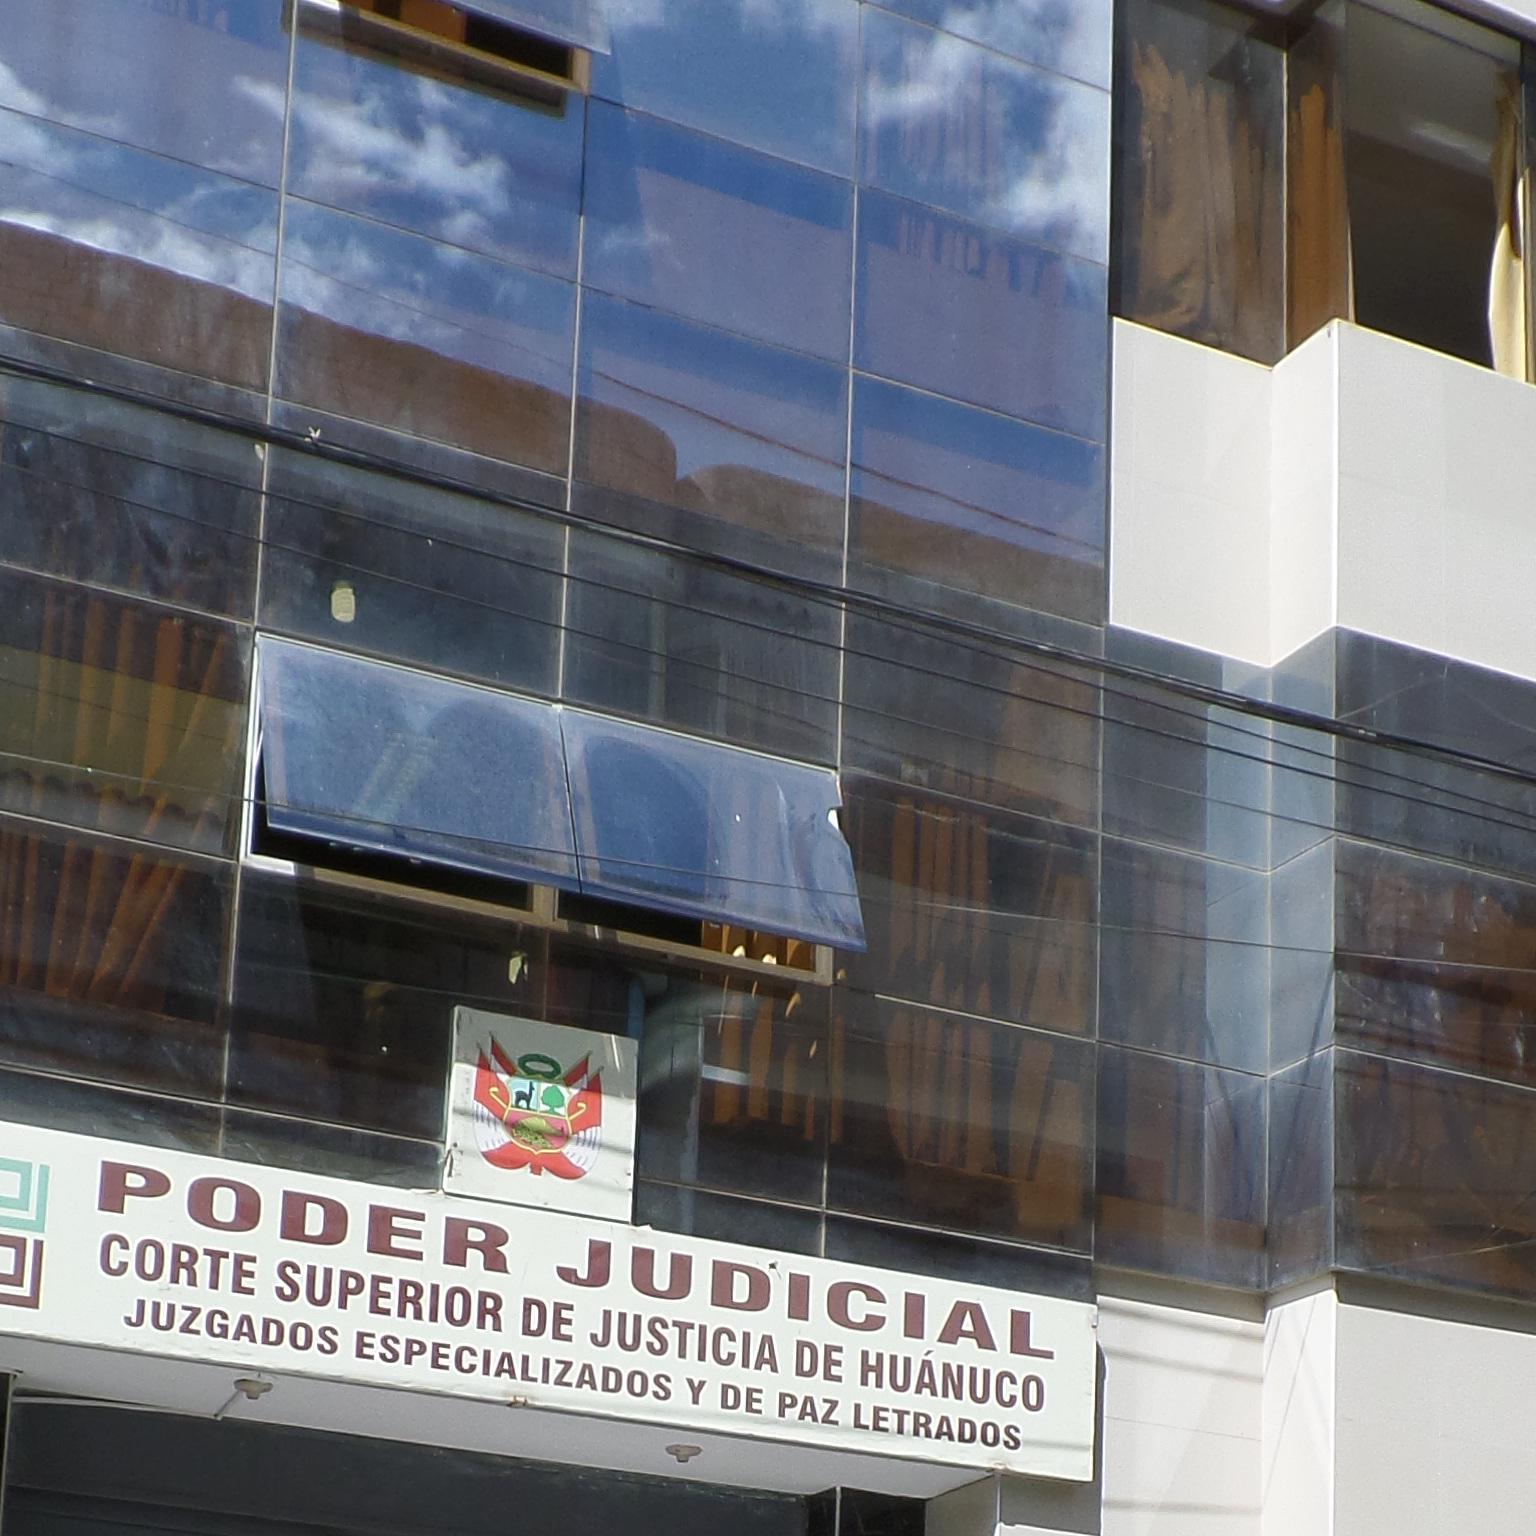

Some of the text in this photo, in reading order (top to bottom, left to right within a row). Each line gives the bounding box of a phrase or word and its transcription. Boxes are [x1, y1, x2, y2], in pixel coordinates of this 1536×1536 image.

[98, 1160, 1055, 1359] PODER JUDICIAL
[100, 1234, 1045, 1412] CORTE SUPERIOR DE JUSTICIA DE HUÁNUCO
[124, 1299, 1021, 1450] JUZGADOS ESPECIALIZADOS Y DE PAZ LETRADOS
